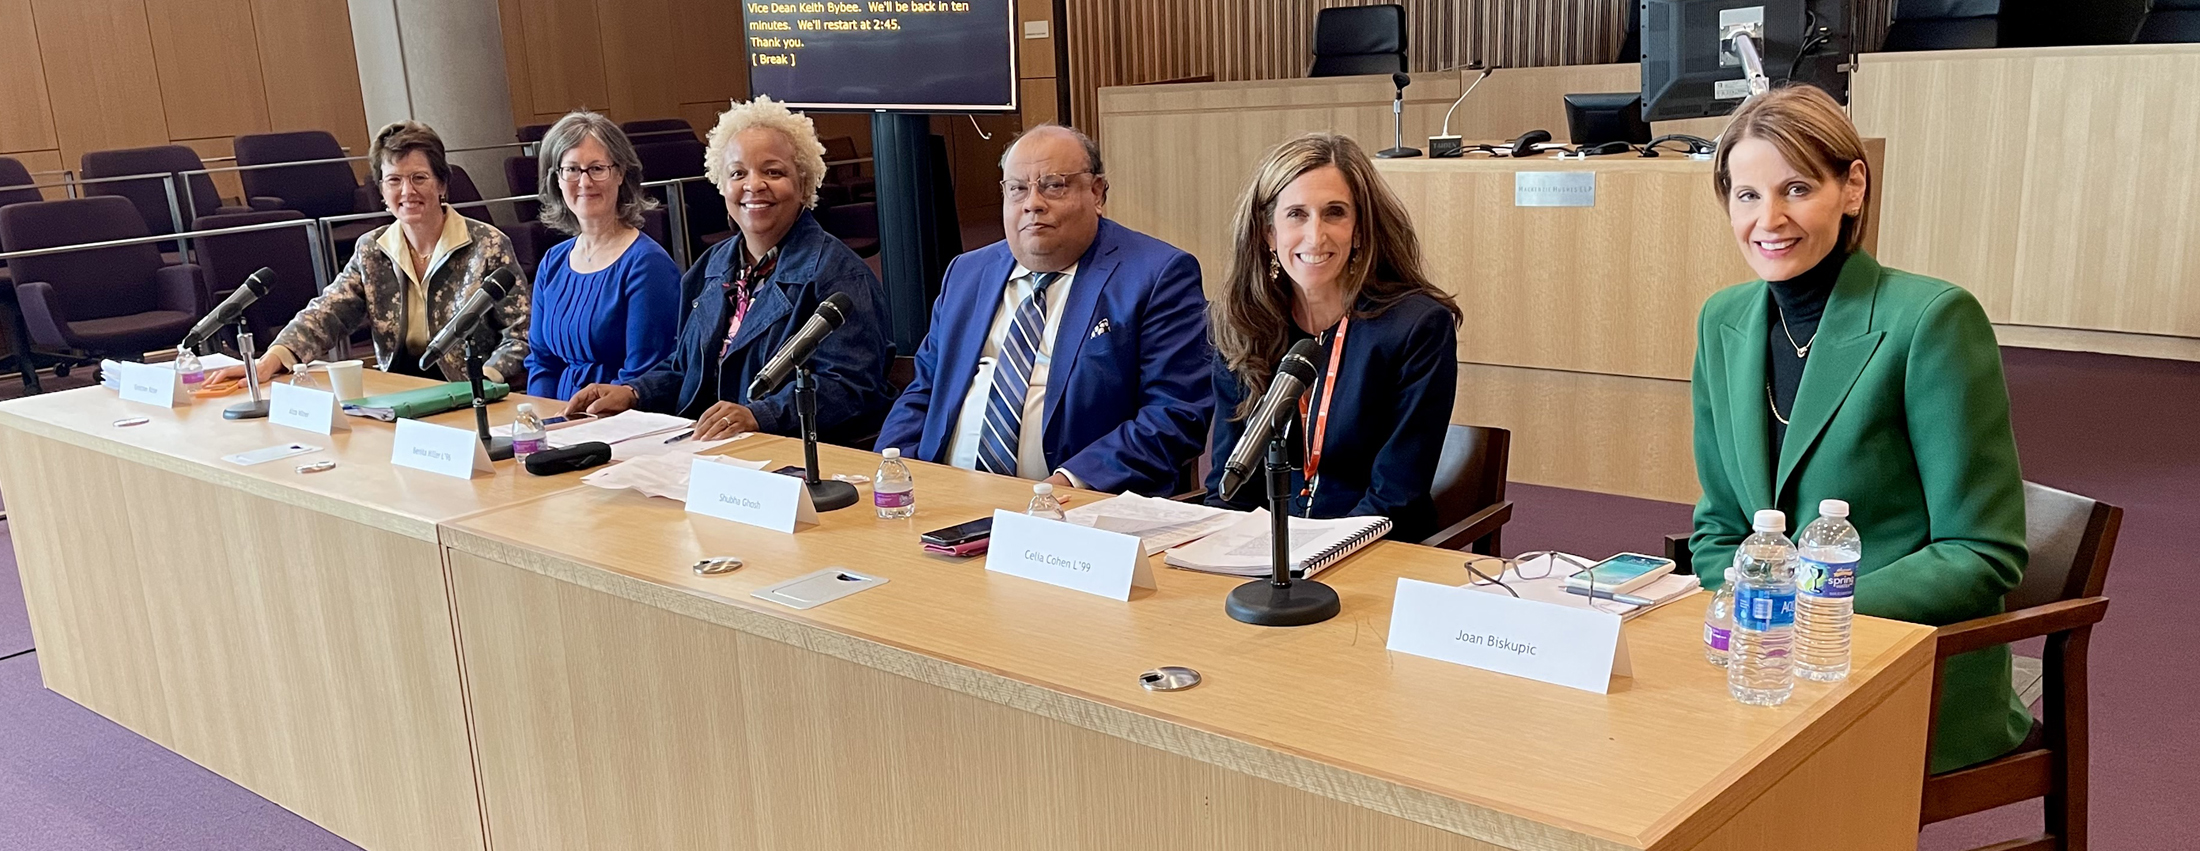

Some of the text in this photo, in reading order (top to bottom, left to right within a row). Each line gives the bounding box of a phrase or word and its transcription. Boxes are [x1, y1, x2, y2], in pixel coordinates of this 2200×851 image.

[747, 0, 970, 14] Vice Dean Keith Bybee. We'll be back in ten
[749, 19, 901, 30] minutes. We'll restart at 2:45.
[750, 37, 805, 49] Thank you.
[760, 53, 788, 65] Break
[719, 493, 761, 510] Shubha Ghosh
[1024, 549, 1044, 563] Celia
[1046, 554, 1071, 569] Cohen
[1455, 629, 1537, 656] Joan Biskupic
